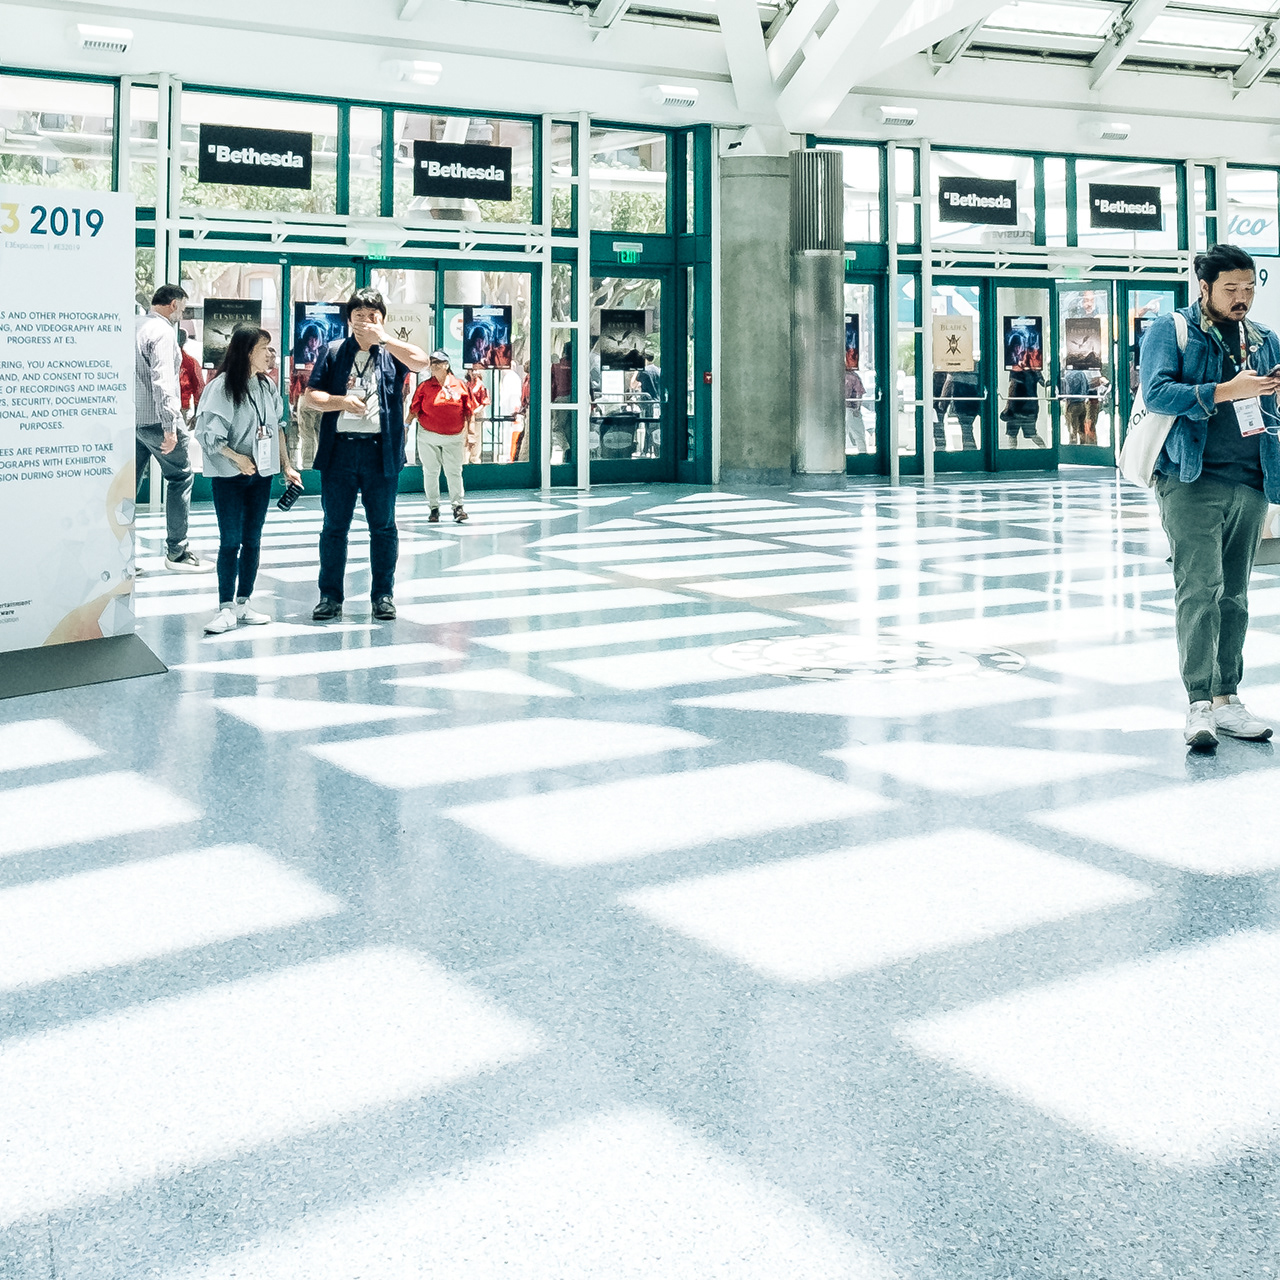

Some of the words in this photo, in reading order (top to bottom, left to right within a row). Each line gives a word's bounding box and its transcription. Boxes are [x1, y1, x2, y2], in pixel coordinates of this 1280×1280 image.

[216, 144, 304, 168] Bethesda
[428, 161, 505, 182] Bethesda
[950, 193, 1011, 209] Bethesda
[1100, 200, 1157, 215] Bethesda
[30, 205, 104, 237] 2019
[8, 312, 27, 320] AND
[29, 312, 56, 320] OTHER
[58, 312, 120, 321] PHOTOGRAPHY,
[15, 324, 33, 332] AND
[36, 324, 94, 332] VIDEOGRAPHY
[7, 336, 51, 344] PROGRESS
[54, 336, 64, 344] AT
[47, 360, 113, 369] ACKNOWLEDGE,
[22, 373, 40, 381] AND
[43, 372, 81, 381] CONSENT
[83, 372, 94, 380] TO
[97, 372, 119, 380] SUCH
[6, 386, 17, 394] OF
[20, 385, 75, 393] RECORDINGS
[77, 384, 94, 392] AND
[97, 383, 127, 391] IMAGES
[55, 396, 117, 405] DOCUMENTARY,
[31, 410, 49, 418] AND
[51, 409, 79, 417] OTHER
[81, 407, 117, 416] GENERAL
[20, 422, 64, 430] PURPOSES.
[16, 447, 33, 455] ARE
[35, 445, 80, 454] PERMITTED
[82, 444, 92, 452] TO
[94, 443, 113, 452] TAKE
[42, 458, 63, 467] WITH
[65, 456, 106, 465] EXHIBITOR
[21, 471, 54, 481] DURING
[56, 470, 81, 478] SHOW
[83, 468, 114, 477] HOURS.
